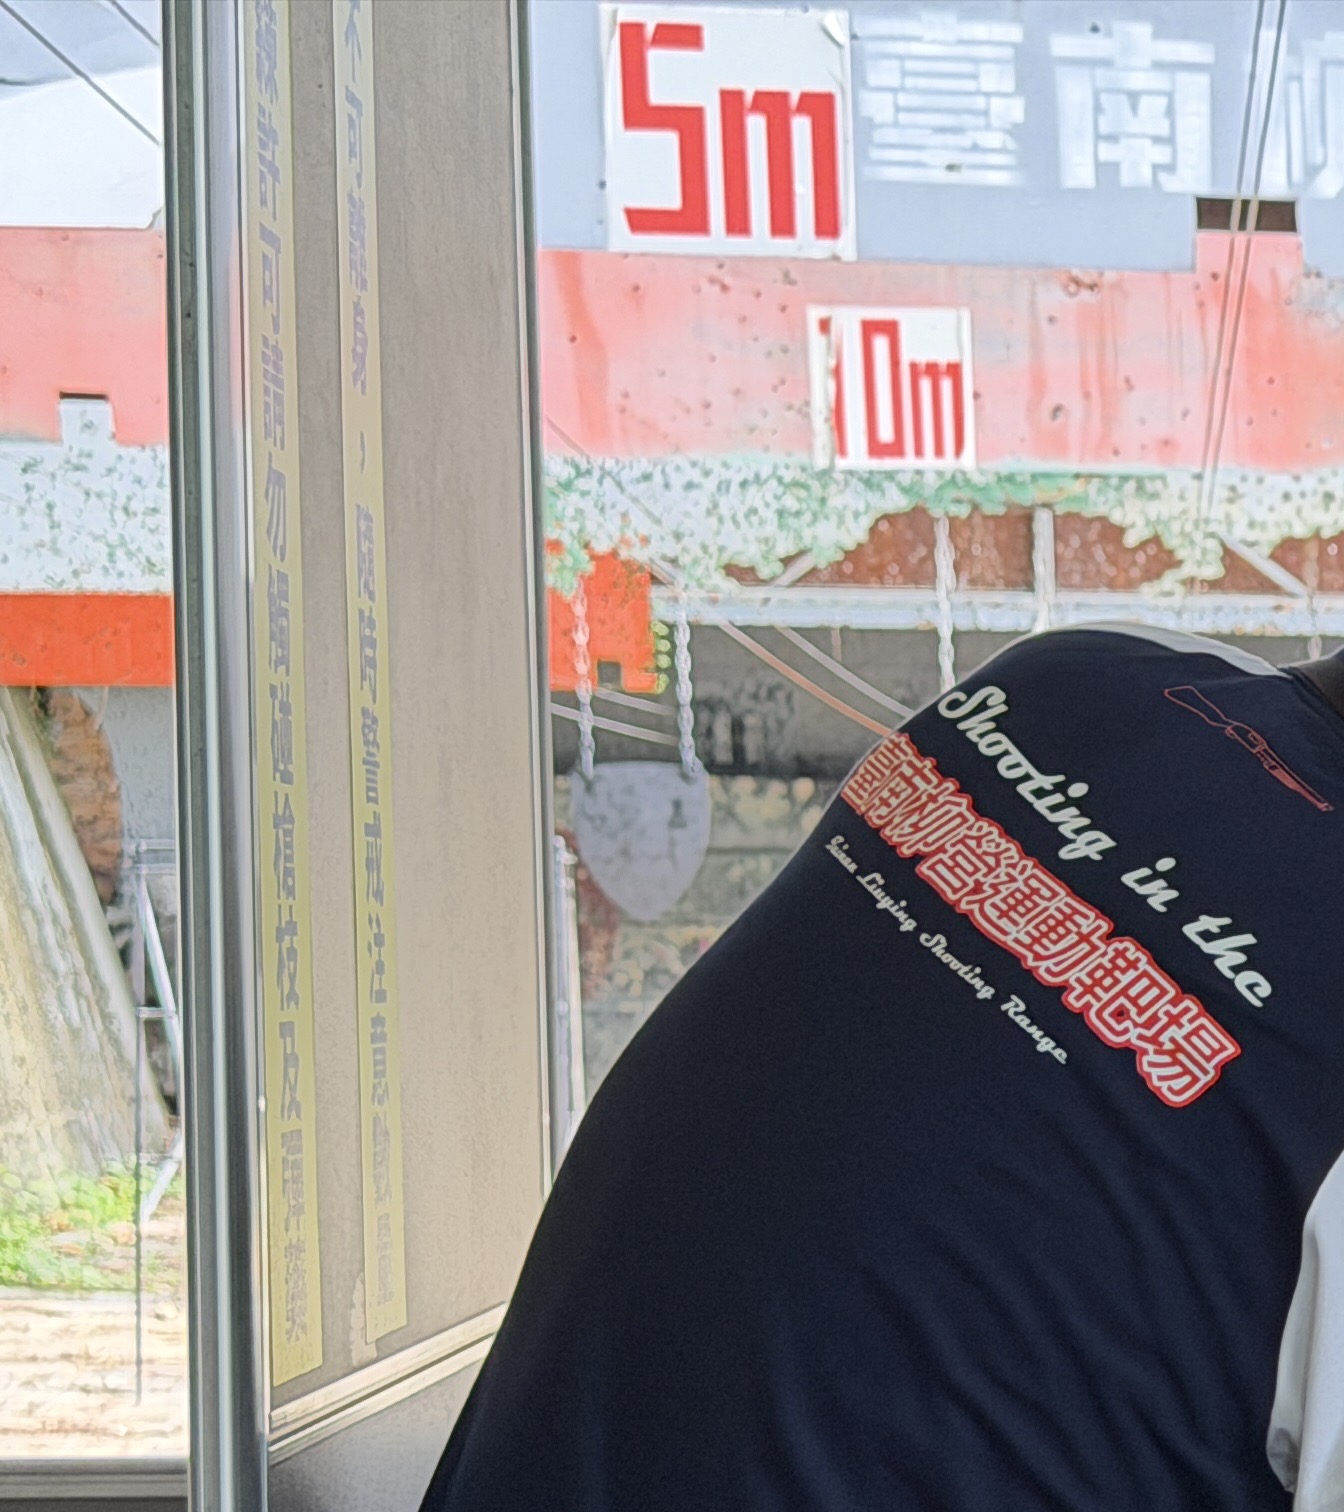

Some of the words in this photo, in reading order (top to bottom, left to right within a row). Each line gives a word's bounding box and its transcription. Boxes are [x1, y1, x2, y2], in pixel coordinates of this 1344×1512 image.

[618, 21, 841, 240] 5m
[818, 317, 965, 460] 10m
[937, 685, 1116, 860] Shooting
[1121, 857, 1180, 912] in
[1181, 914, 1273, 1007] the
[919, 932, 995, 1000] Shooting
[1000, 994, 1068, 1065] Range
